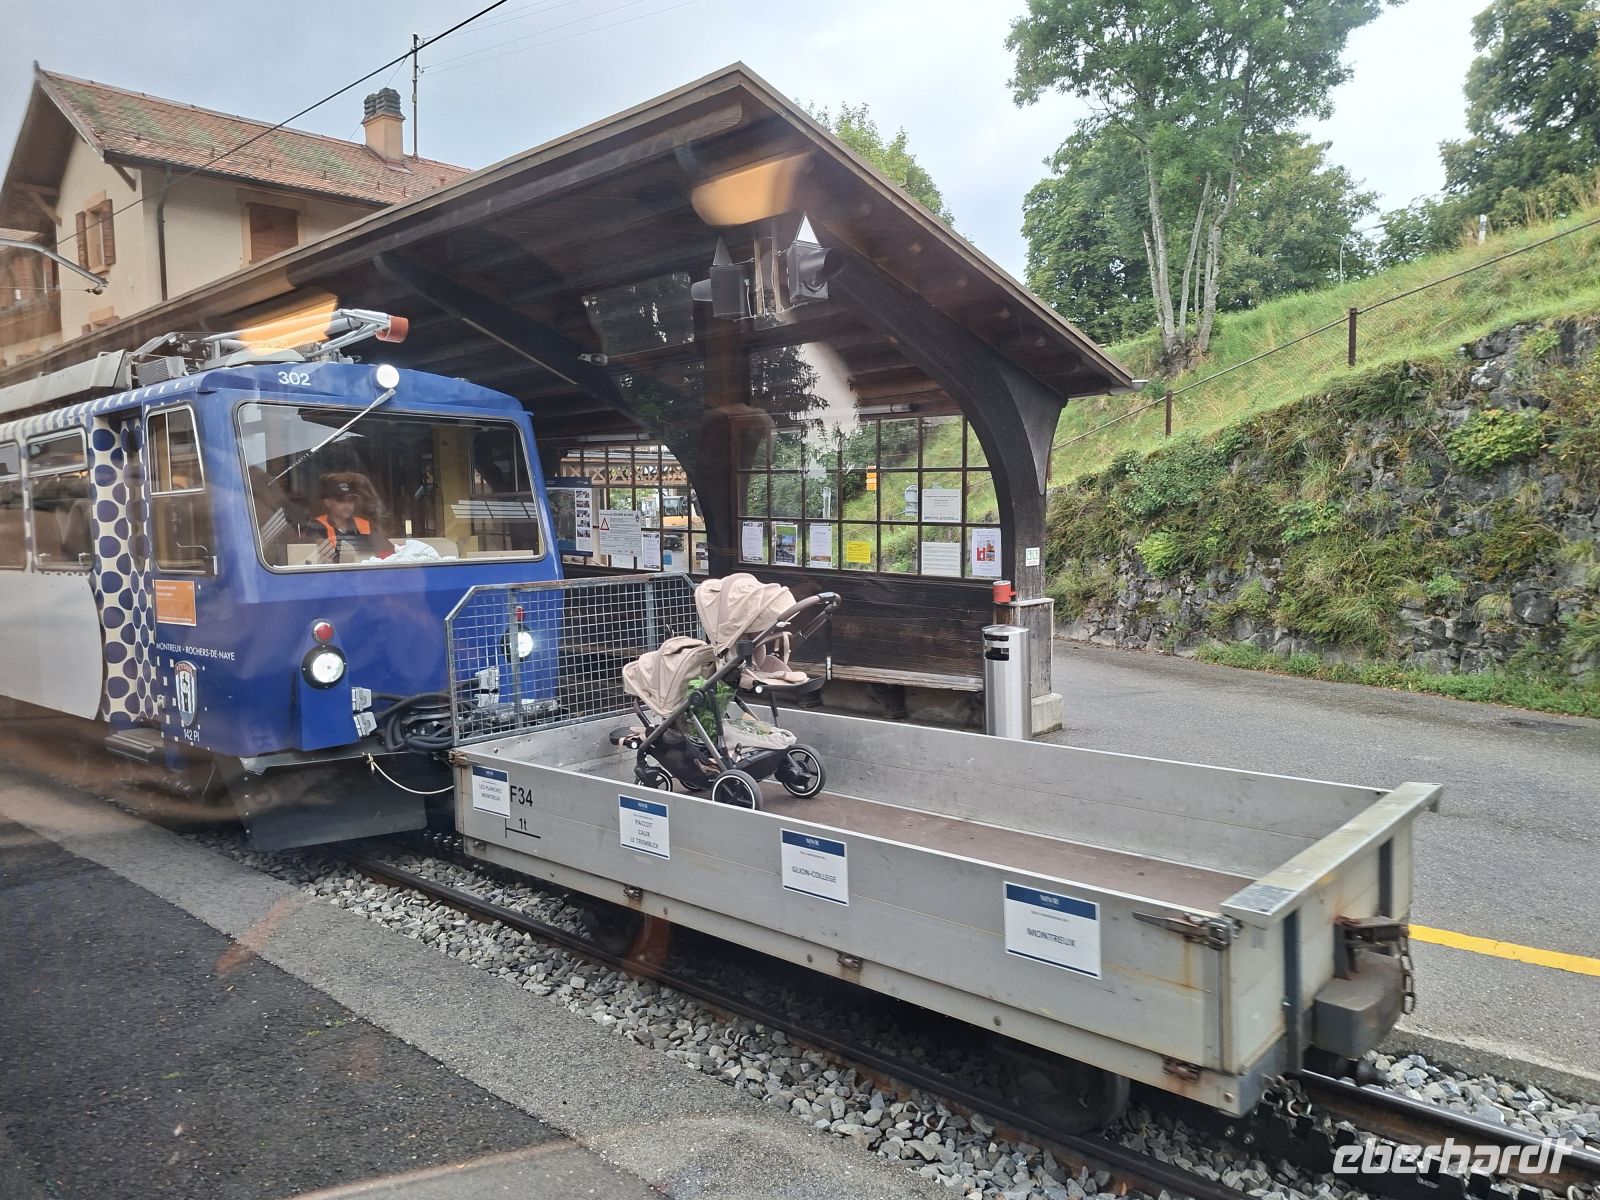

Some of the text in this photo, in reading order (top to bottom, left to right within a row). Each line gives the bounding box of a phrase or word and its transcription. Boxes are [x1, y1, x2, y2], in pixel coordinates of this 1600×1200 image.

[278, 371, 311, 386] 302
[156, 642, 235, 660] MONTREUX ROCHERS-DE-NAYE
[183, 729, 193, 740] 142
[510, 785, 533, 807] F34
[519, 817, 527, 831] 1t
[638, 829, 650, 837] CAUX
[1026, 928, 1076, 947] MONTREUX
